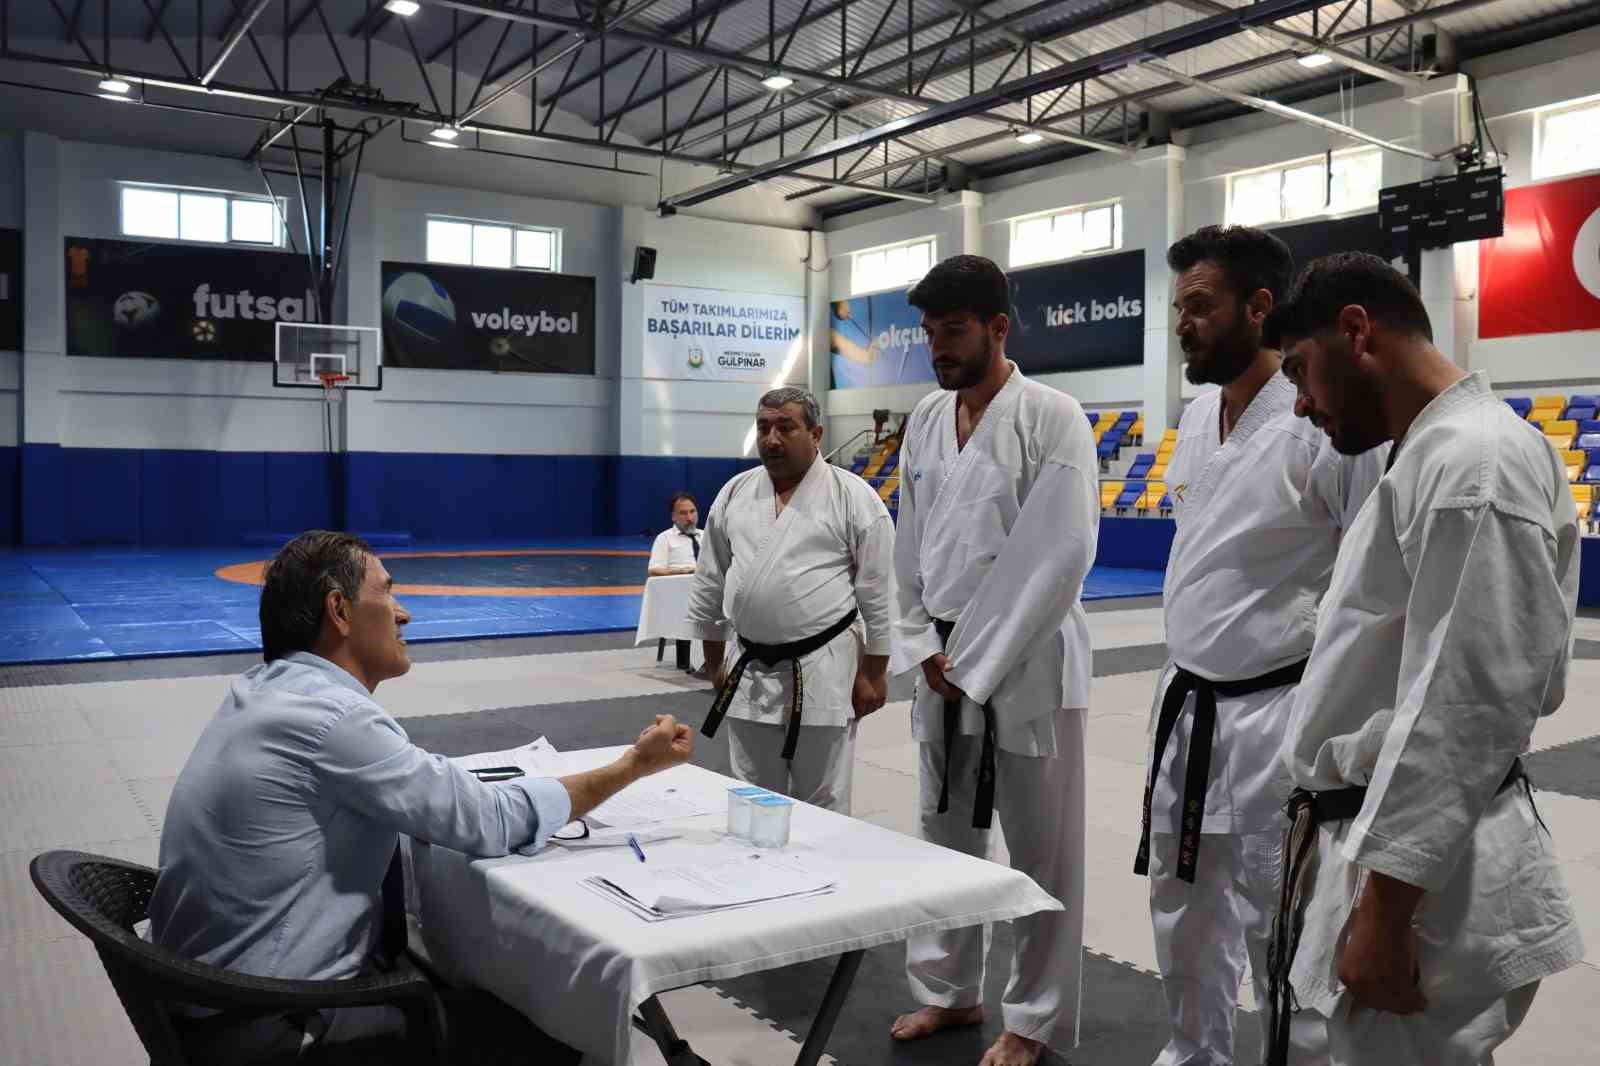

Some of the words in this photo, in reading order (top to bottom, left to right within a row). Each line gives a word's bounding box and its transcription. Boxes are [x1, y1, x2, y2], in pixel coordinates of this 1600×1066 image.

[193, 283, 316, 322] futsal
[661, 299, 689, 314] TÜM
[693, 303, 788, 321] TAKIMLARIMIZA
[1046, 302, 1087, 327] kick
[1090, 296, 1142, 320] boks
[471, 307, 578, 336] voleybol
[647, 318, 737, 340] BAŞARILAR
[741, 321, 800, 341] DİLERİM
[718, 356, 766, 368] GÜLPINAR
